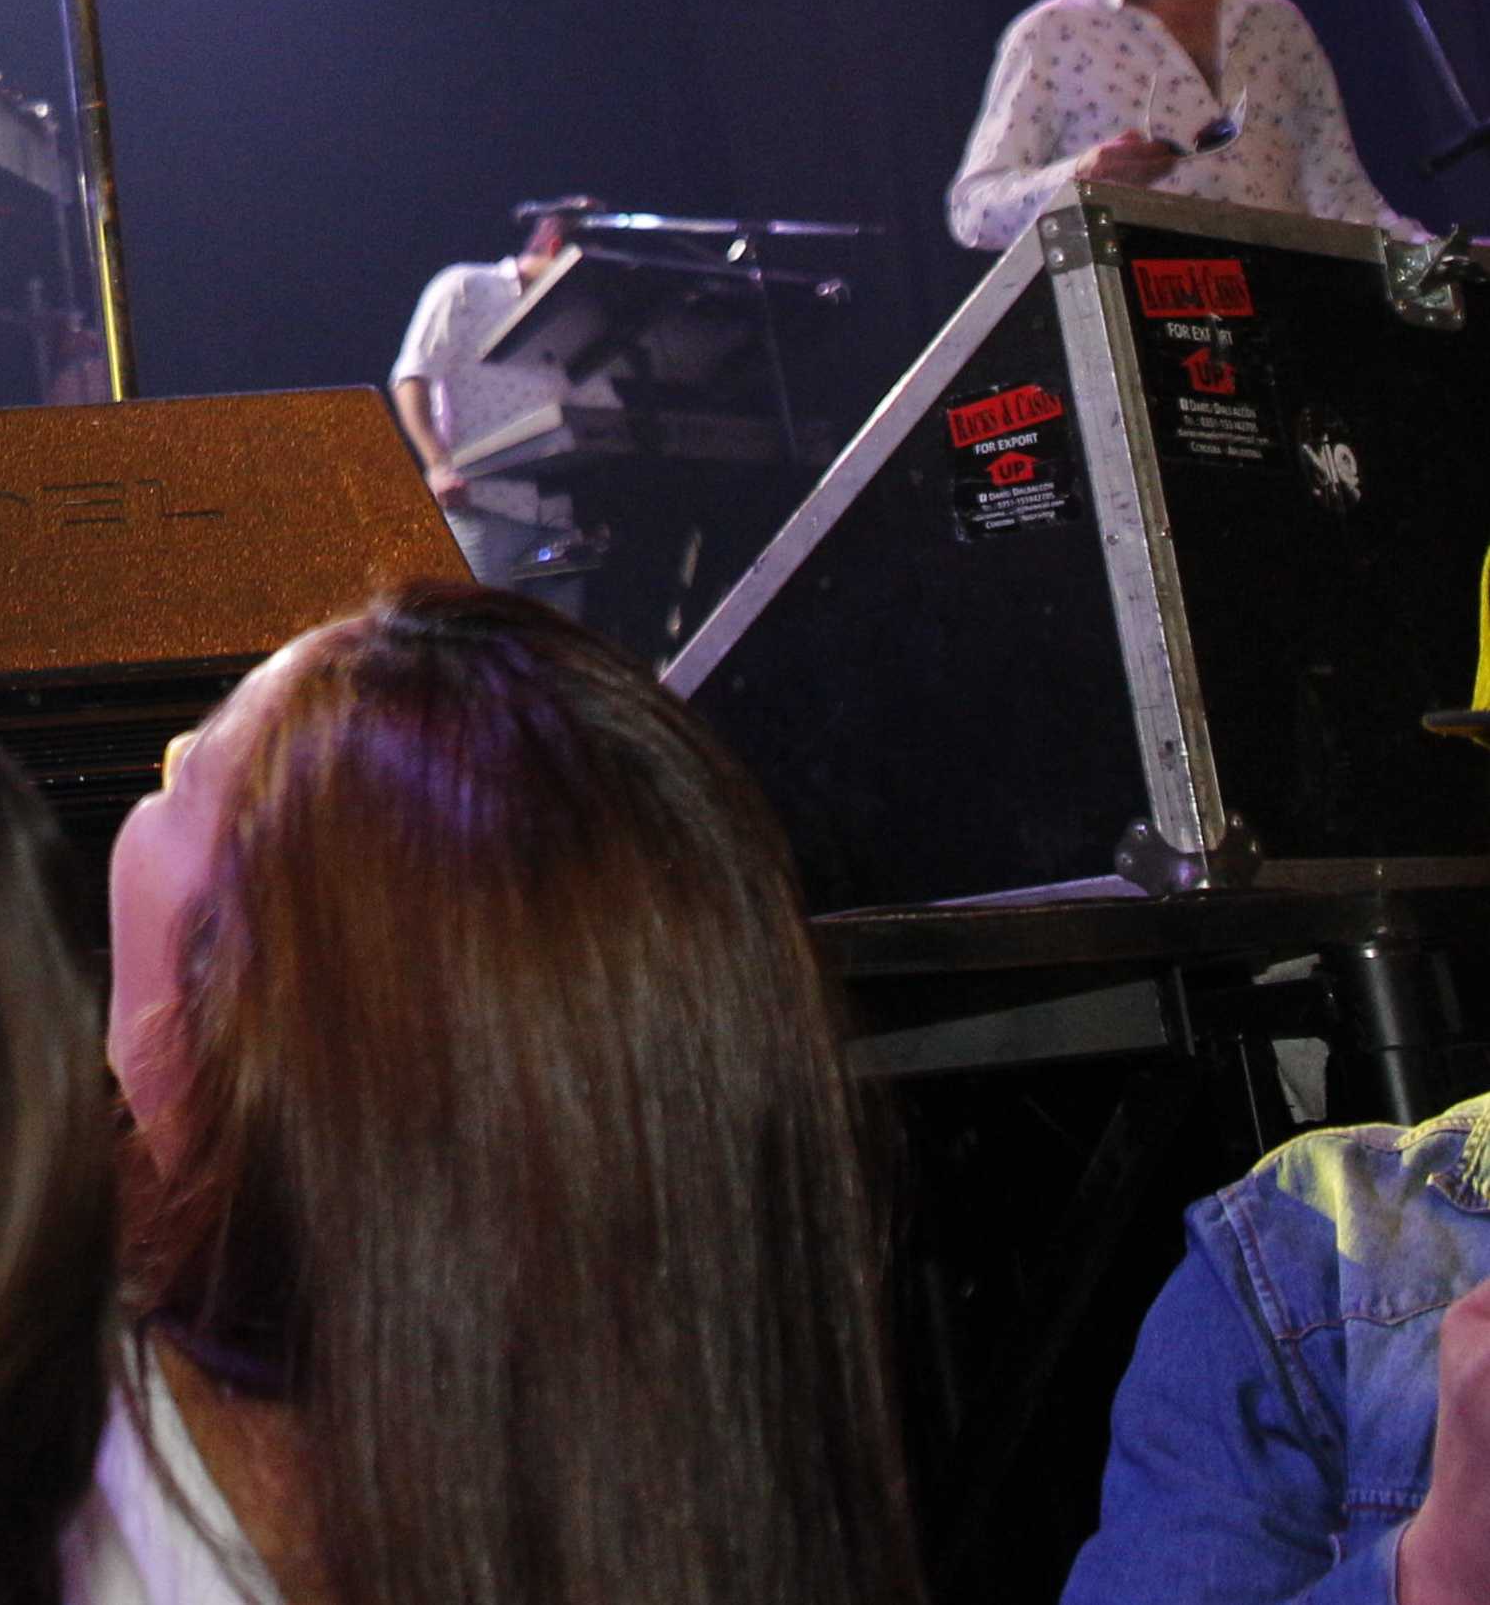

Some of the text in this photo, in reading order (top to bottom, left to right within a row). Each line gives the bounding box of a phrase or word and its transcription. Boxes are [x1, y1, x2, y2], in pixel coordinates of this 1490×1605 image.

[1166, 322, 1191, 340] FOR
[974, 432, 1039, 455] FOR EXPORT
[998, 459, 1027, 479] UP
